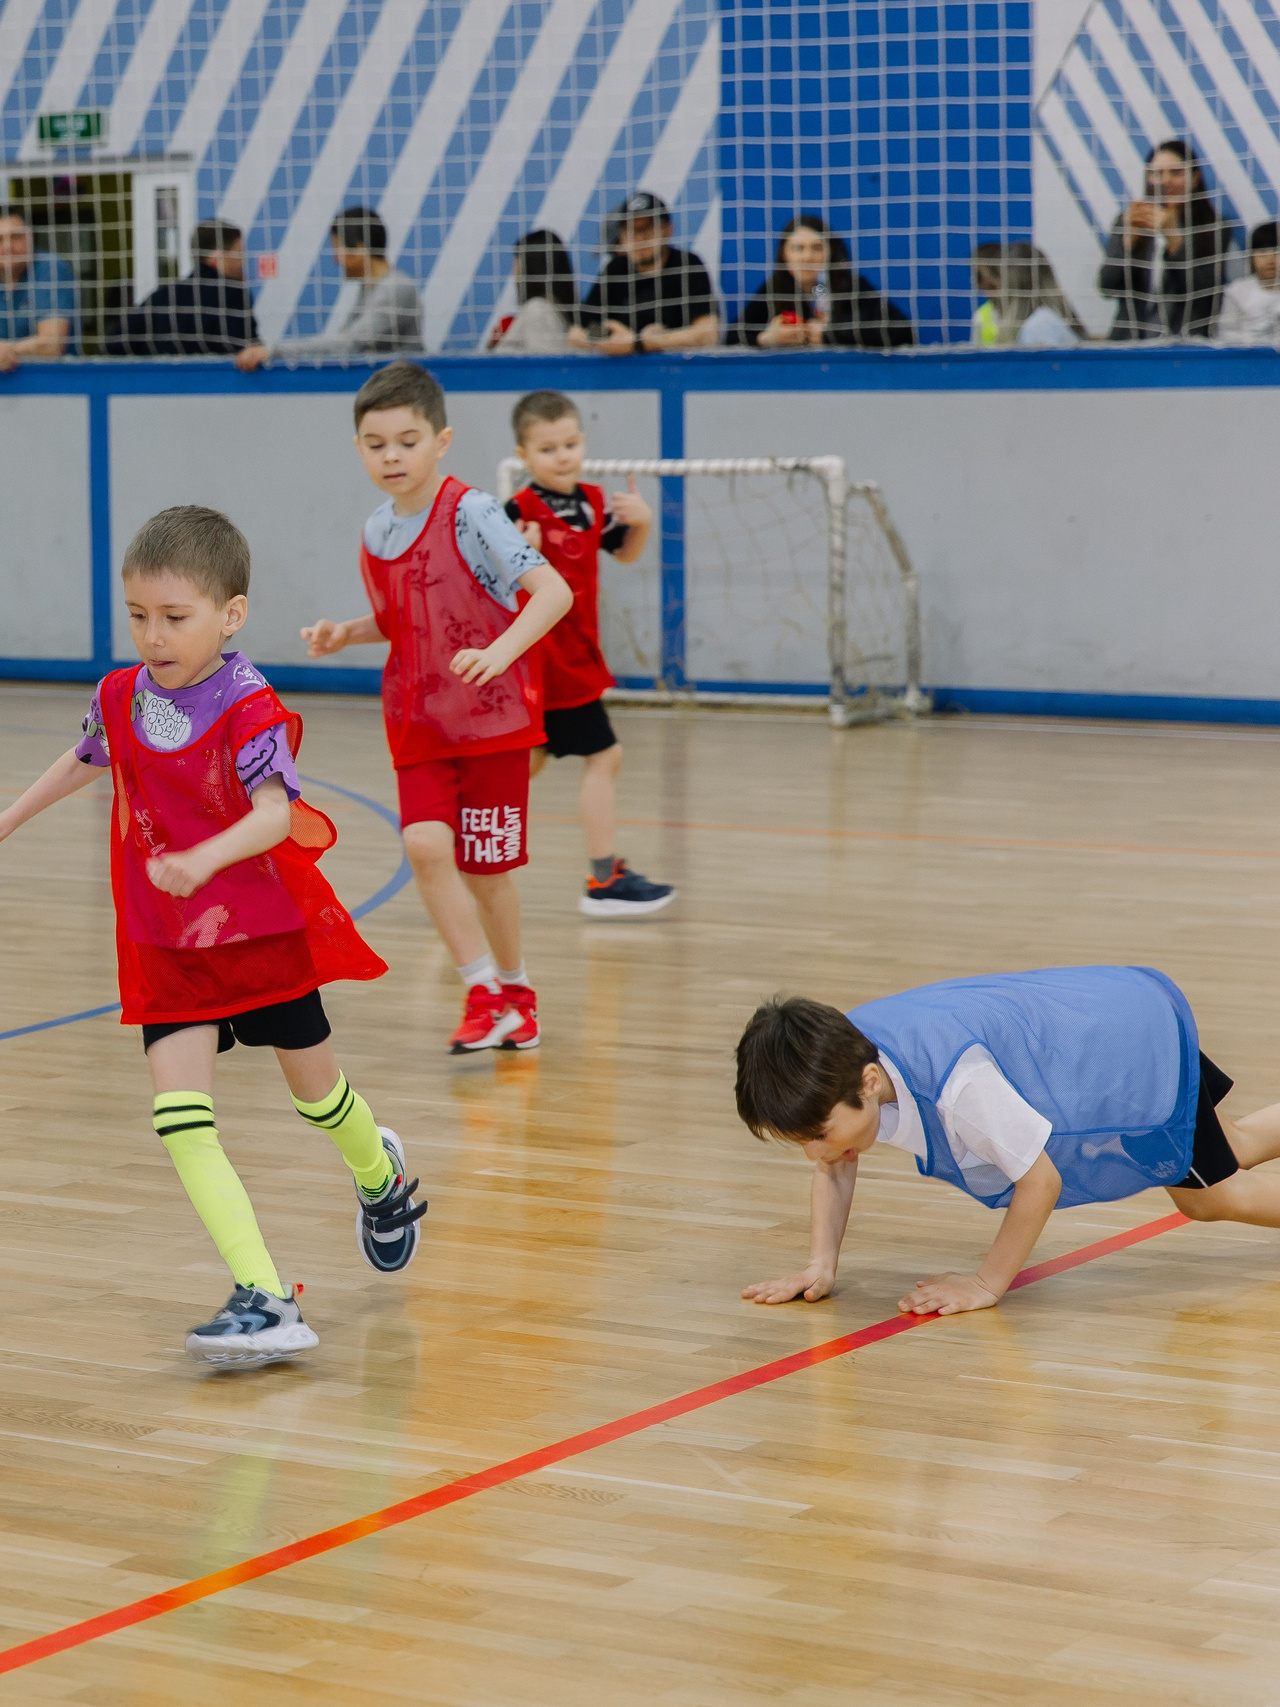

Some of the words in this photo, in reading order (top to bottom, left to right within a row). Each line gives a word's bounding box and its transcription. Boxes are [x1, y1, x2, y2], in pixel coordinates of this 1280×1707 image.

[461, 806, 505, 836] FEEL
[503, 805, 522, 862] MOMENT
[461, 833, 504, 864] THE
